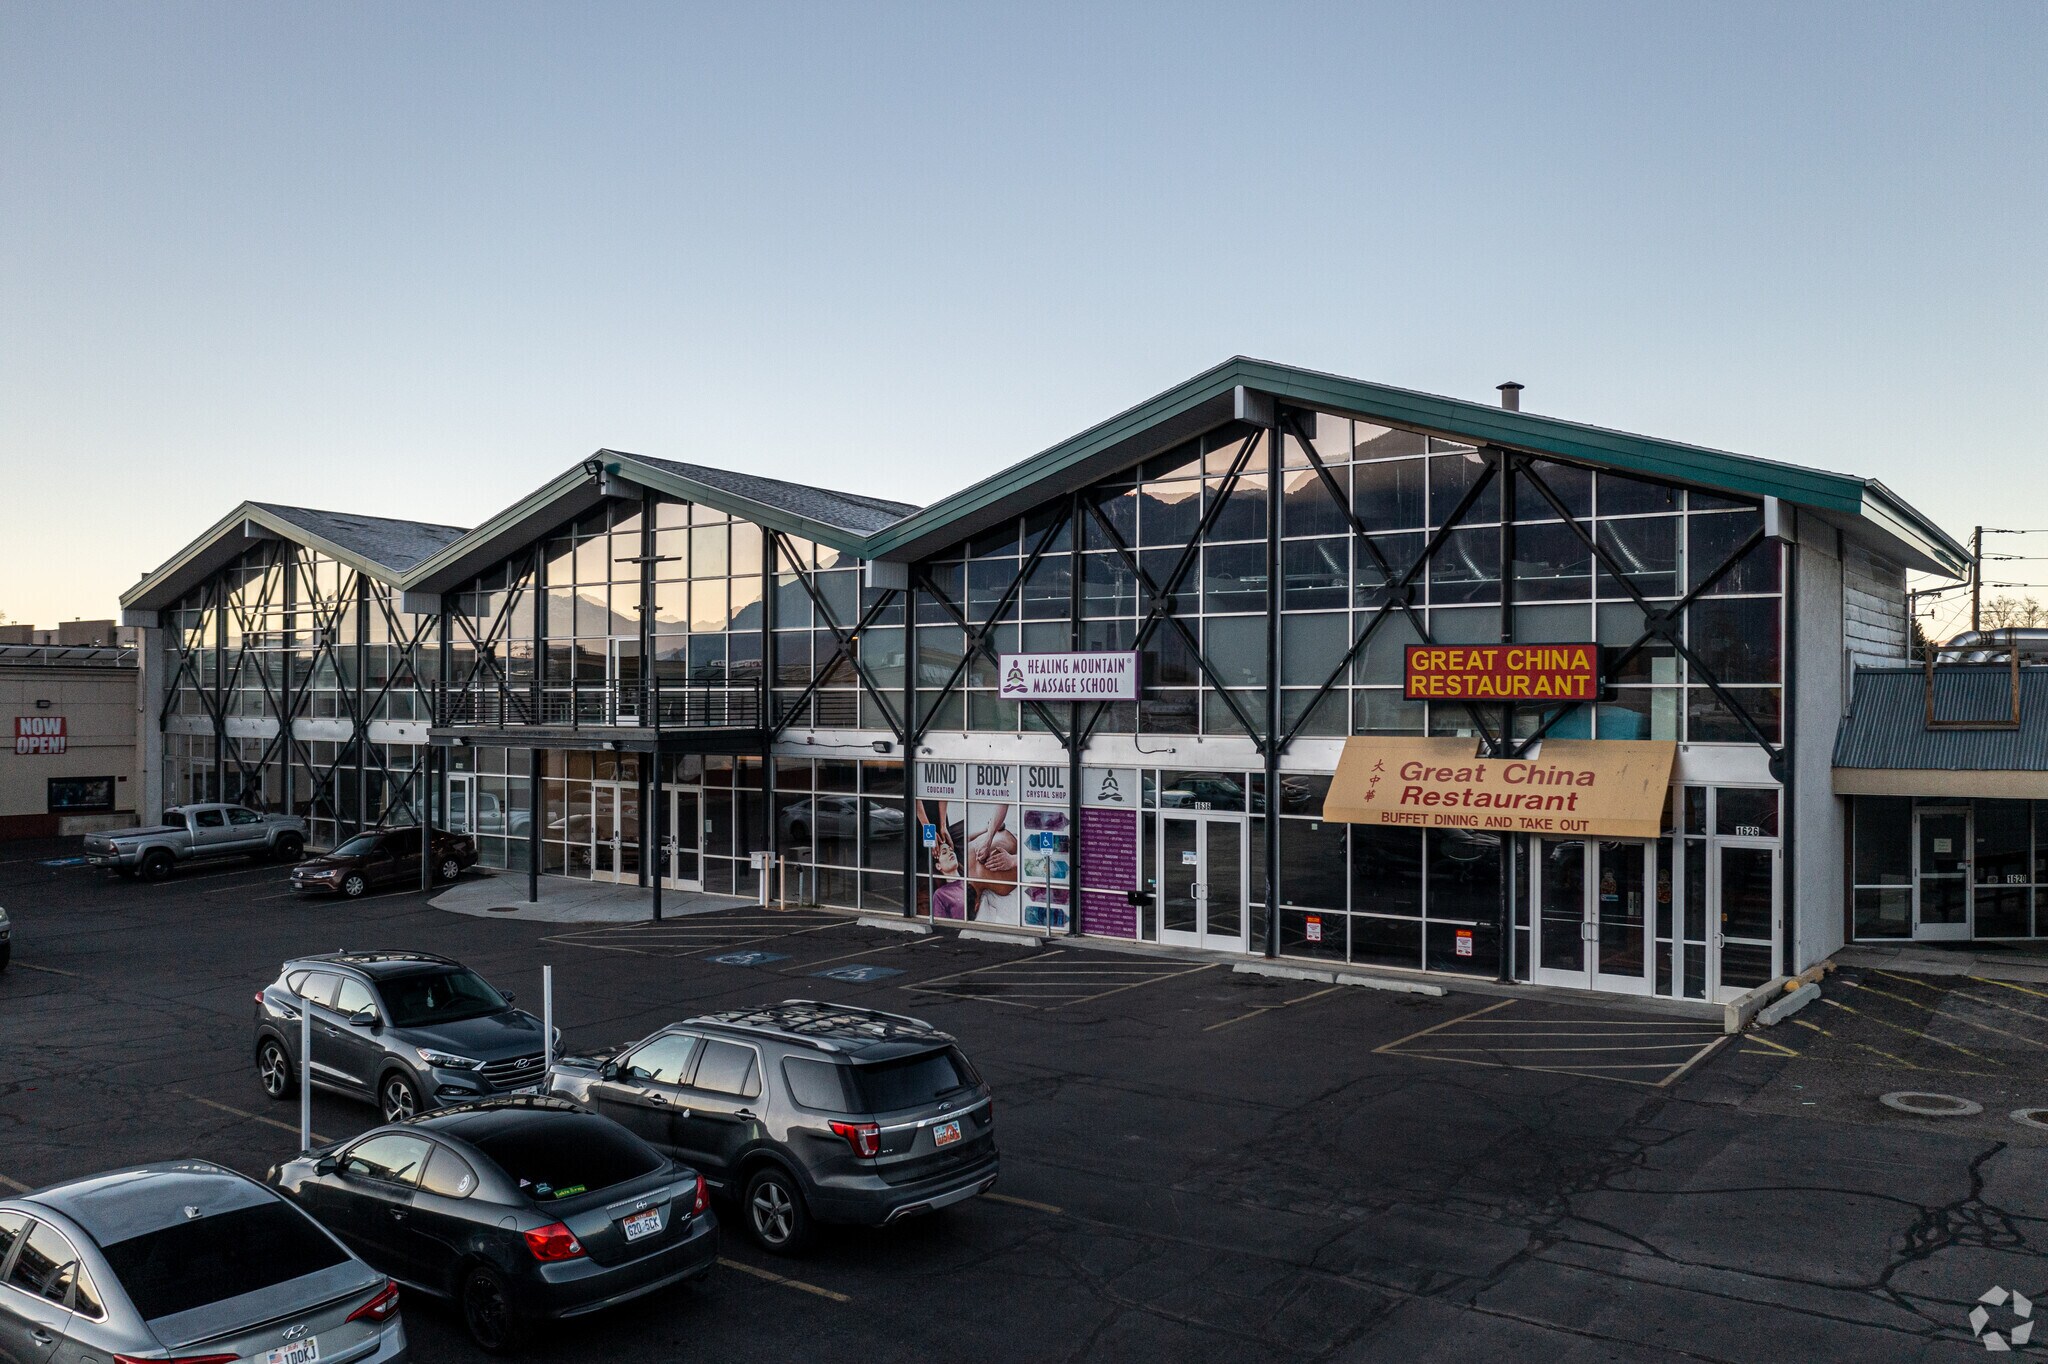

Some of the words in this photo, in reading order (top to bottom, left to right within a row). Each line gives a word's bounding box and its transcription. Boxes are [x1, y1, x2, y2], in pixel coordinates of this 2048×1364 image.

[1028, 659, 1069, 674] HEALING
[1411, 649, 1498, 671] GREAT
[1506, 649, 1590, 671] CHINA
[1033, 678, 1077, 693] MASSAGE
[1080, 678, 1119, 693] SCHOOL
[1411, 675, 1590, 697] RESTAURANT
[20, 717, 62, 736] NOW
[16, 736, 65, 754] OPEN!
[924, 763, 957, 784] MIND
[977, 765, 1010, 786] BODY
[1029, 766, 1064, 789] SOUL
[1400, 761, 1486, 783] Great
[1503, 763, 1596, 787] China
[926, 785, 955, 794] EDUCATION
[975, 788, 985, 796] SPA
[986, 788, 991, 796] &
[992, 789, 1010, 797] CLINIC
[1026, 790, 1050, 799] CRYSTAL
[1052, 791, 1067, 800] SHOP
[1400, 785, 1579, 812] Restaurant
[1381, 811, 1429, 825] BUFFET
[1434, 813, 1479, 827] DINING
[1484, 815, 1513, 829] AND
[1518, 816, 1553, 831] TAKE
[1559, 818, 1589, 832] OUT
[1737, 826, 1760, 836] 1626
[2007, 874, 2027, 884] 1620
